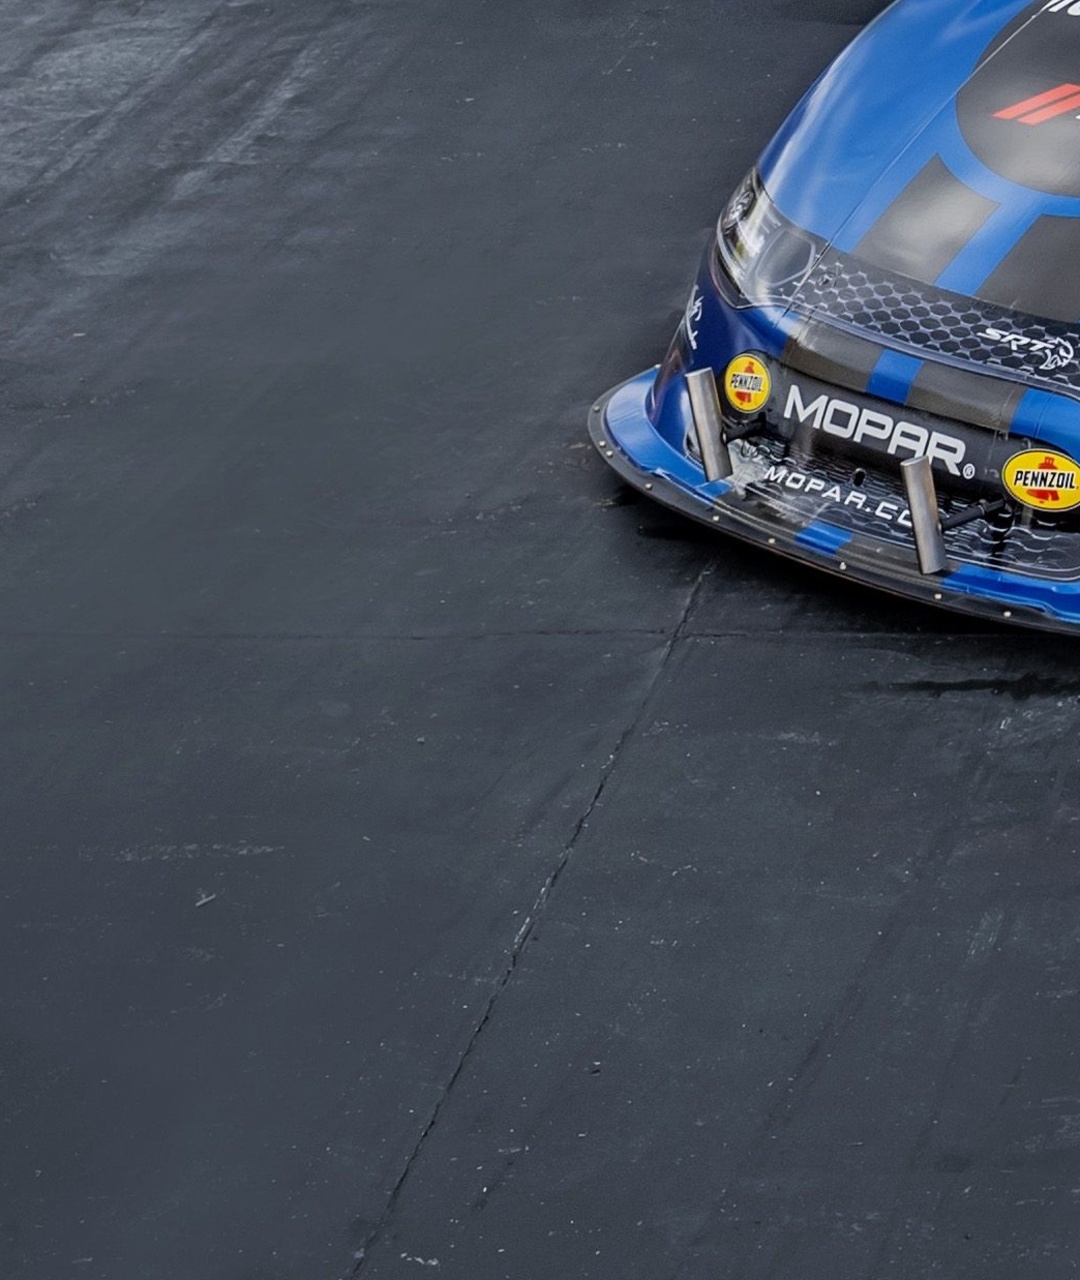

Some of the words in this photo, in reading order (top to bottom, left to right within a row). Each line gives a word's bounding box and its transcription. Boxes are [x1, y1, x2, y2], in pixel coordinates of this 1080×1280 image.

[976, 327, 1056, 352] SRT
[1013, 470, 1077, 490] PENNZOIL
[763, 465, 913, 528] MOPAR.CO
